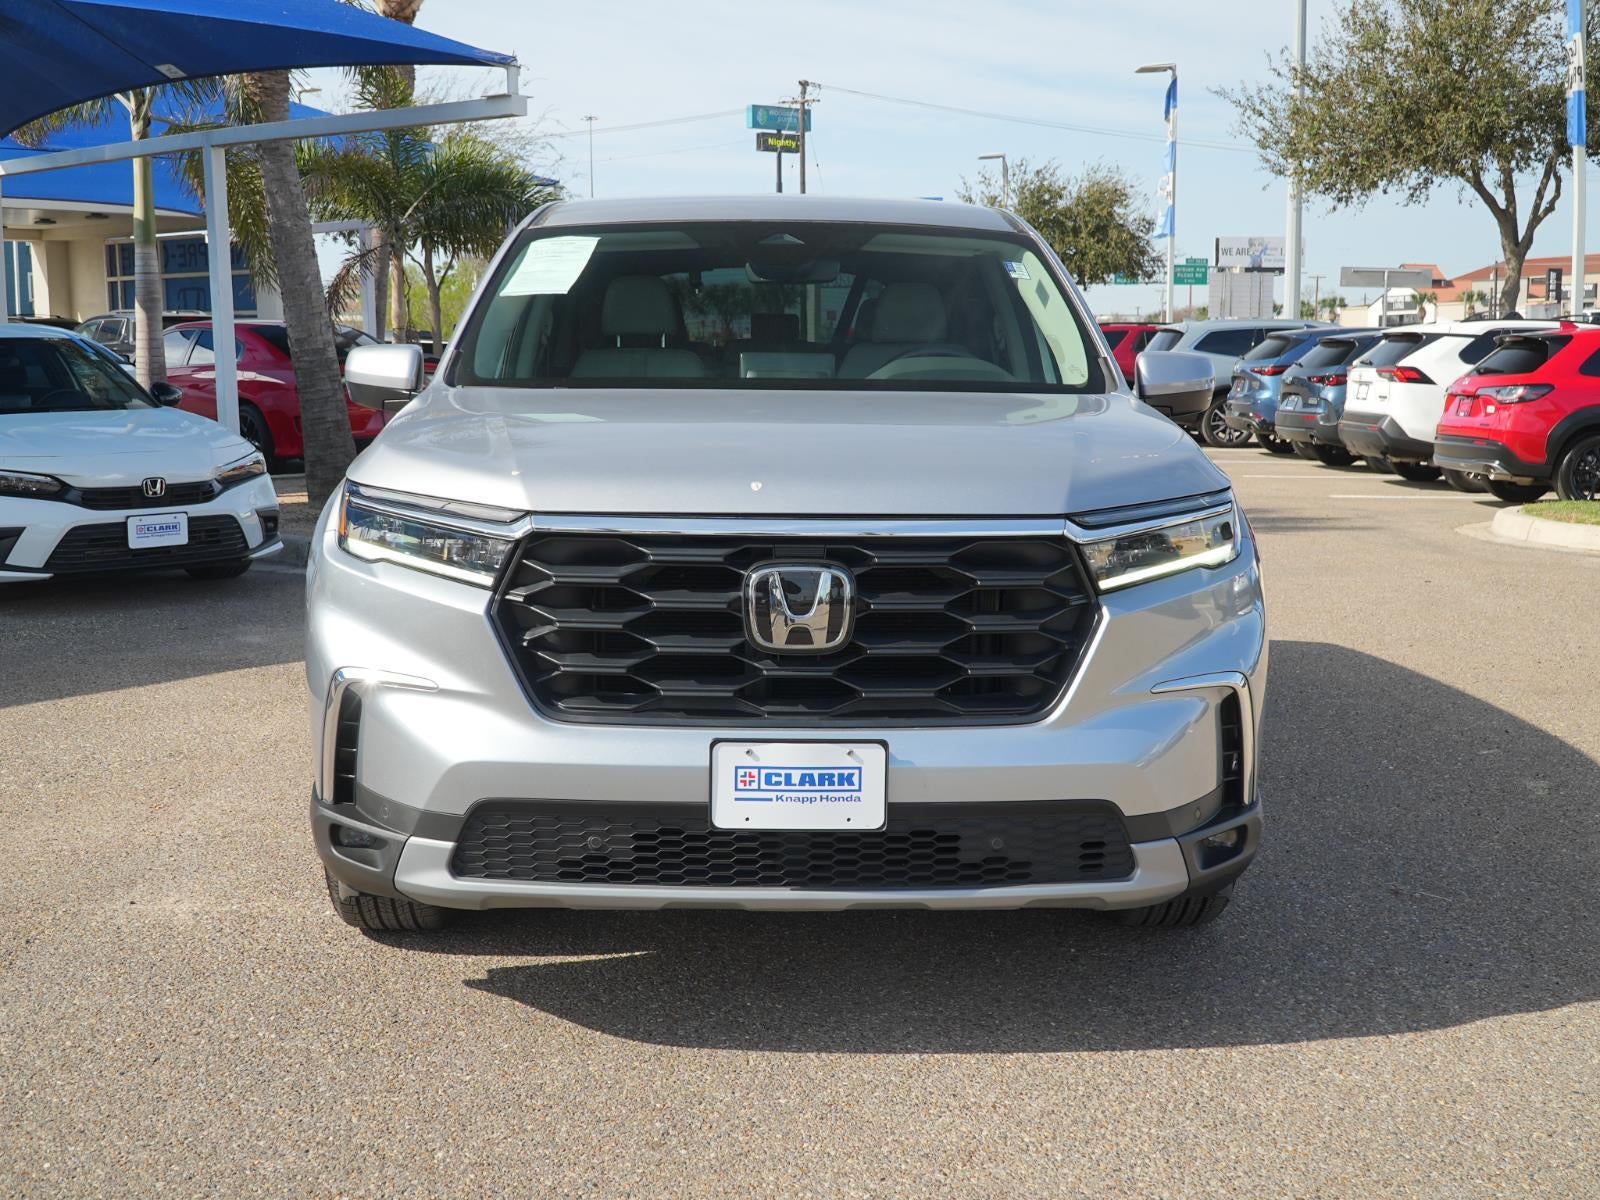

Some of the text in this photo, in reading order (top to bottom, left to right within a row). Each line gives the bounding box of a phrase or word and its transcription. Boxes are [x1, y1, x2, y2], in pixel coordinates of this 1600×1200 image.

[768, 137, 796, 149] Nightly
[1221, 247, 1250, 256] WE ARE
[147, 524, 178, 532] CLARK
[764, 772, 856, 787] CLARK
[775, 794, 862, 805] Knapp Honda
